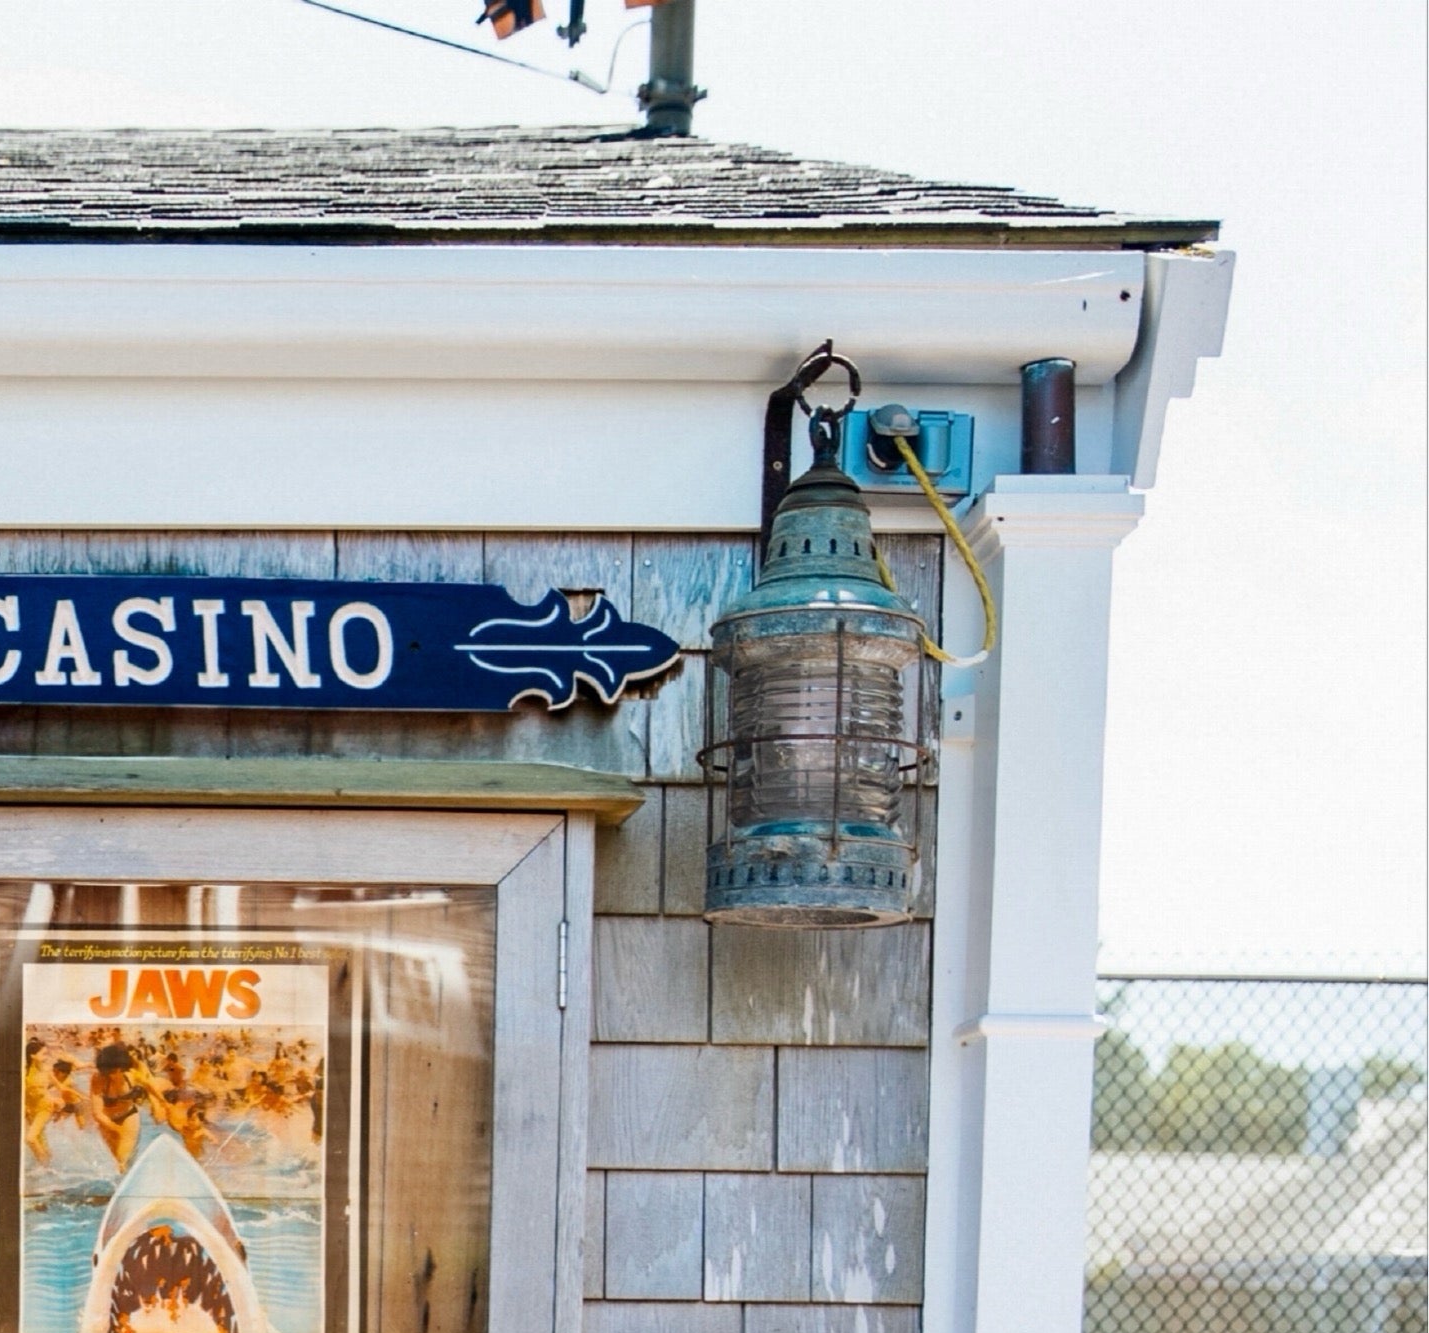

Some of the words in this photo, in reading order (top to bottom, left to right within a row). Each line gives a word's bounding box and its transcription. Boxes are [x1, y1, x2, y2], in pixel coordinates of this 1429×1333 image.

[41, 945, 61, 957] The
[64, 945, 110, 960] terrifying
[89, 968, 261, 1020] JAWS
